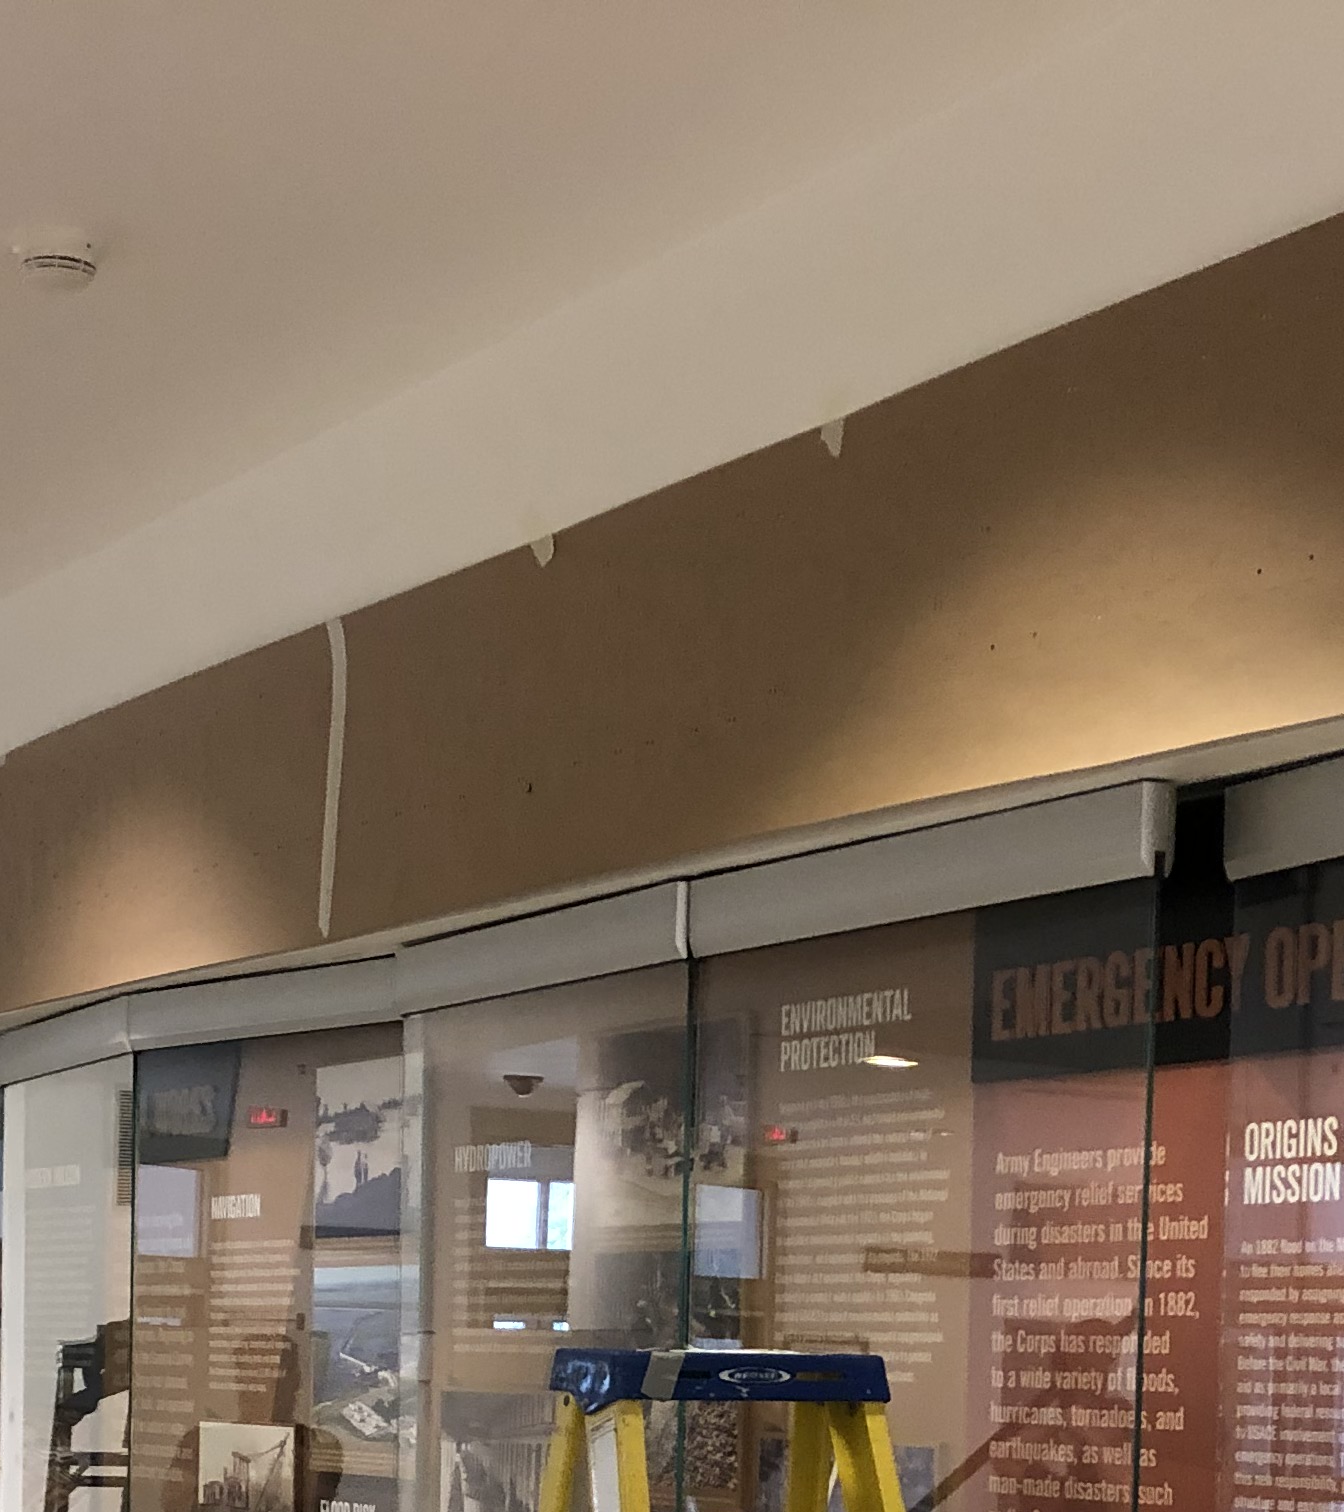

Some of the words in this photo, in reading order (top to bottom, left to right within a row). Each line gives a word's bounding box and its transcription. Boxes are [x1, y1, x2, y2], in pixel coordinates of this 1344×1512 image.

[991, 932, 1250, 1042] EMERGENCY
[781, 988, 912, 1037] ENVIRONMENTAL
[780, 1030, 876, 1072] PROTECTION
[1244, 1116, 1338, 1161] ORIGINS
[455, 1139, 532, 1173] HYDROPOWER
[996, 1151, 1029, 1177] Army
[1034, 1149, 1102, 1175] Engineers
[995, 1189, 1071, 1213] emergency
[1075, 1183, 1112, 1206] relief
[1243, 1162, 1341, 1205] MISSION
[994, 1223, 1036, 1248] during
[1041, 1221, 1105, 1243] disasters
[1159, 1216, 1208, 1239] United
[993, 1257, 1034, 1279] States
[1039, 1257, 1064, 1279] and
[1068, 1256, 1123, 1278] abroad.
[1023, 1294, 1059, 1315] relief
[1159, 1293, 1199, 1319] 1882,
[991, 1330, 1012, 1352] the
[1016, 1330, 1055, 1356] Corps
[1020, 1367, 1050, 1389] wide
[1055, 1368, 1103, 1395] variety
[1155, 1407, 1183, 1429] and
[988, 1475, 1059, 1498] man-made
[1138, 1482, 1172, 1504] such
